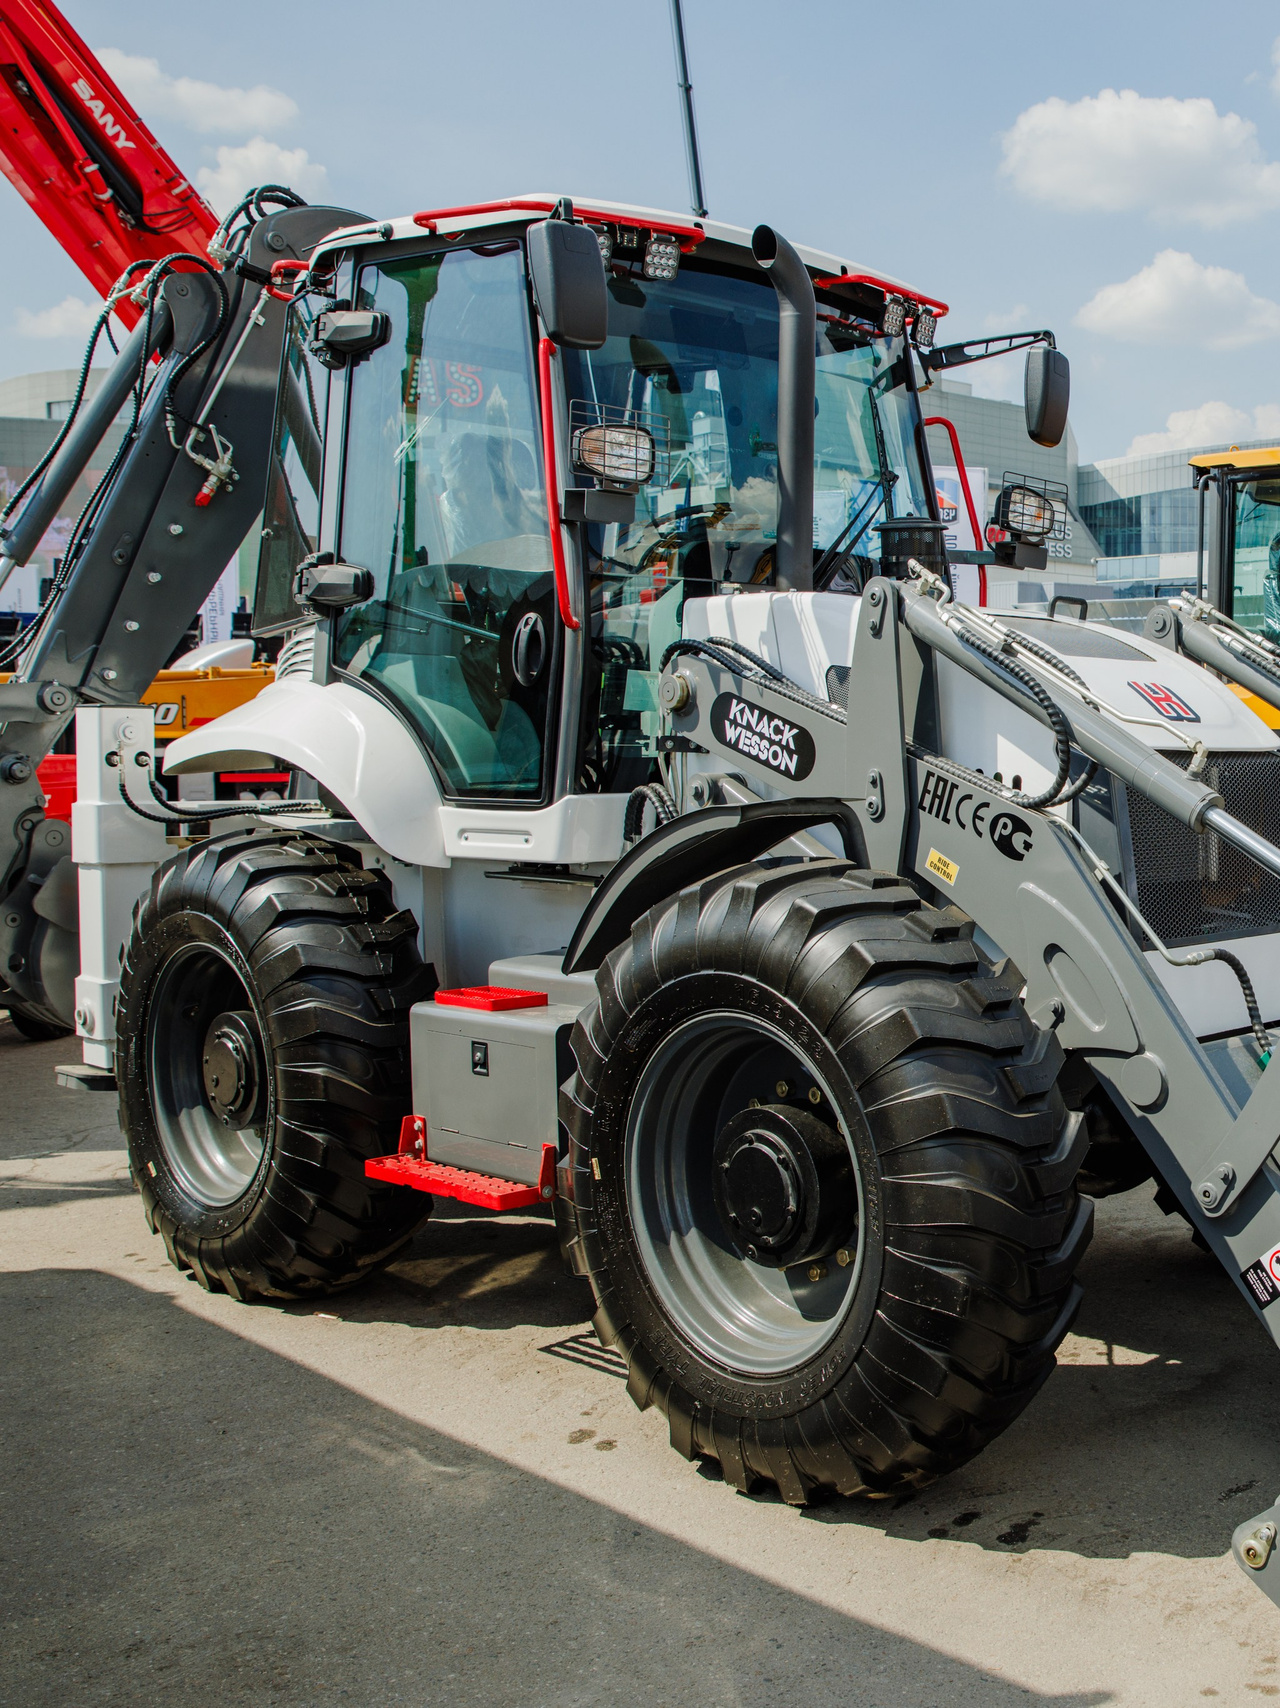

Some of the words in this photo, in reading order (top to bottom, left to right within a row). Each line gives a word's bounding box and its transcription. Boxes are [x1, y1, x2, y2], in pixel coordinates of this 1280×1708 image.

[71, 78, 137, 149] SANY
[725, 720, 798, 776] WESSON
[729, 698, 799, 750] KNACK
[929, 860, 953, 881] CONTROL
